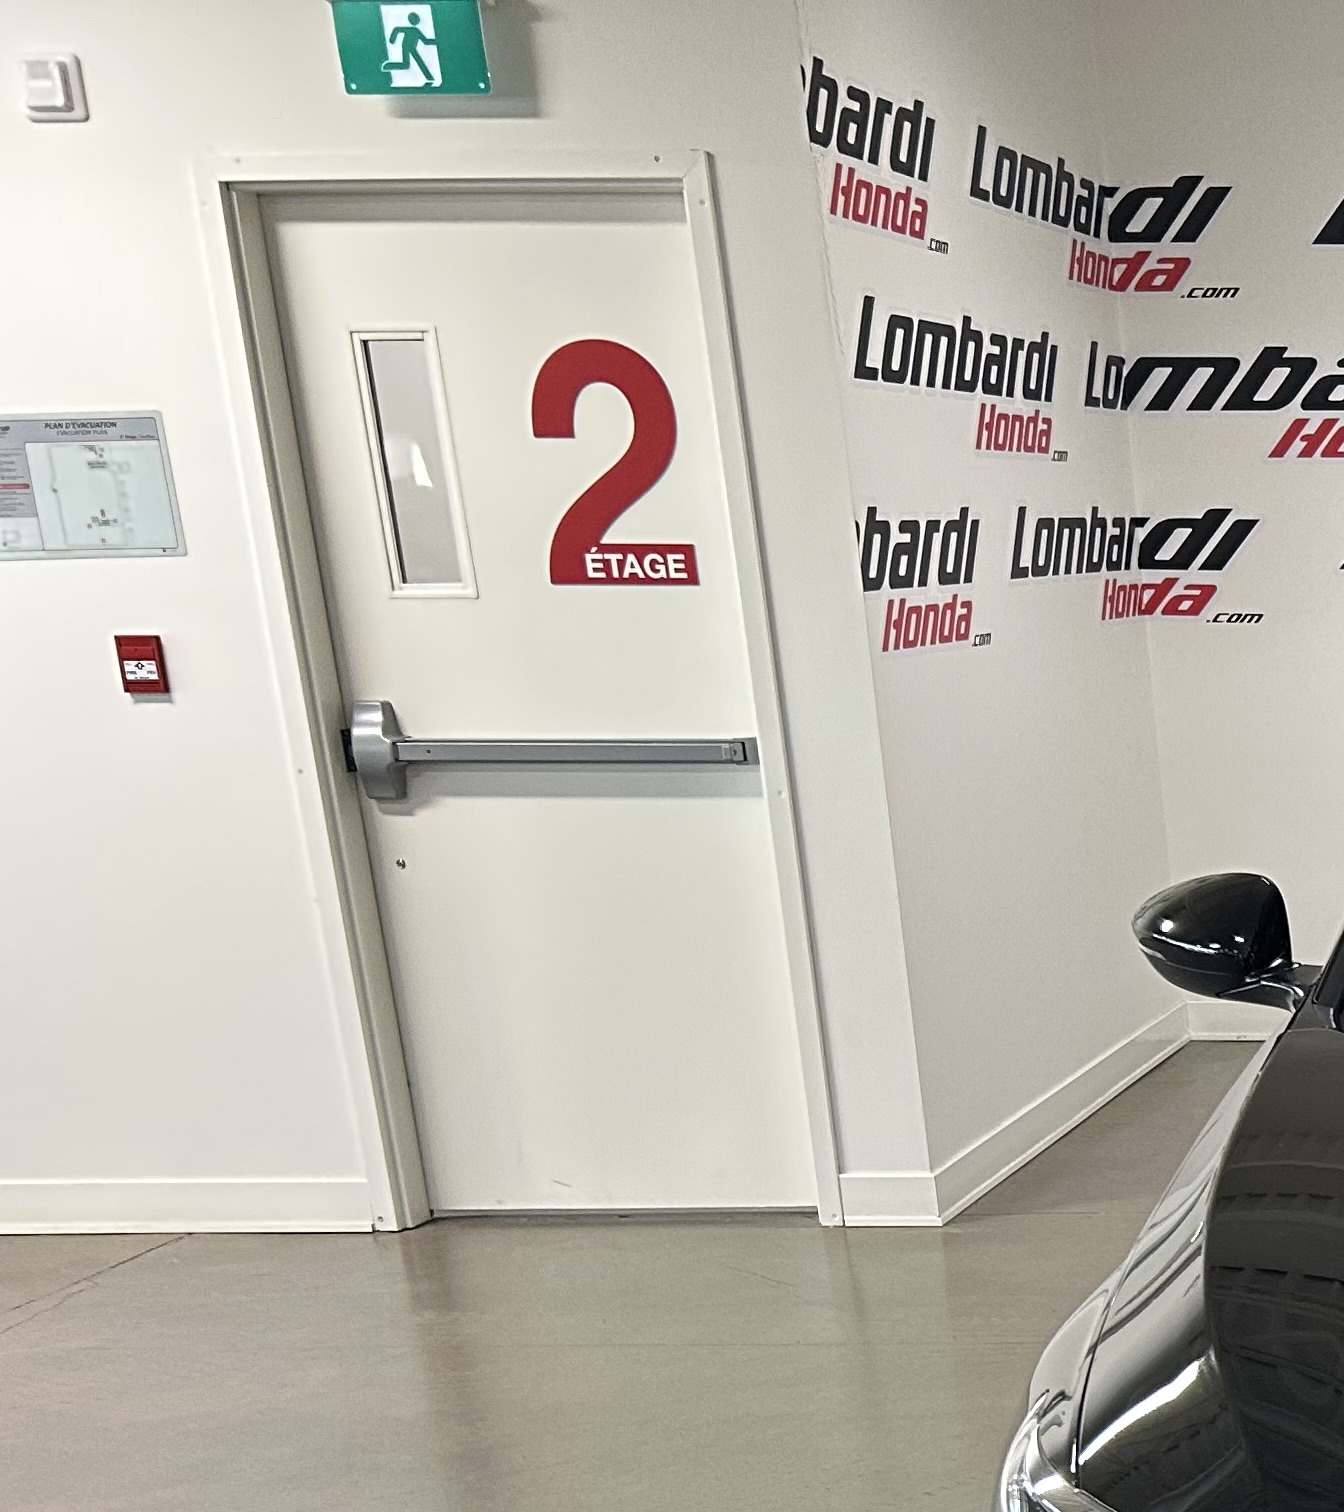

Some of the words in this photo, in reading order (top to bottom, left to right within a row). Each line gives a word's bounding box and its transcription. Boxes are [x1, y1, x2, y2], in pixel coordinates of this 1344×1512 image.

[800, 57, 935, 182] bardi
[830, 163, 928, 240] Honda
[970, 125, 1232, 243] Lombardi
[1068, 239, 1191, 292] Honda
[1180, 286, 1240, 298] .com
[854, 296, 1058, 402] Lombardi
[532, 339, 700, 585] 2
[976, 403, 1051, 454] Honda
[585, 547, 688, 578] ÉTAGE
[854, 507, 979, 592] bardi
[1010, 506, 1260, 580] Lombardi
[882, 595, 972, 652] Honda
[1102, 577, 1217, 620] Honda
[1206, 612, 1263, 623] .com
